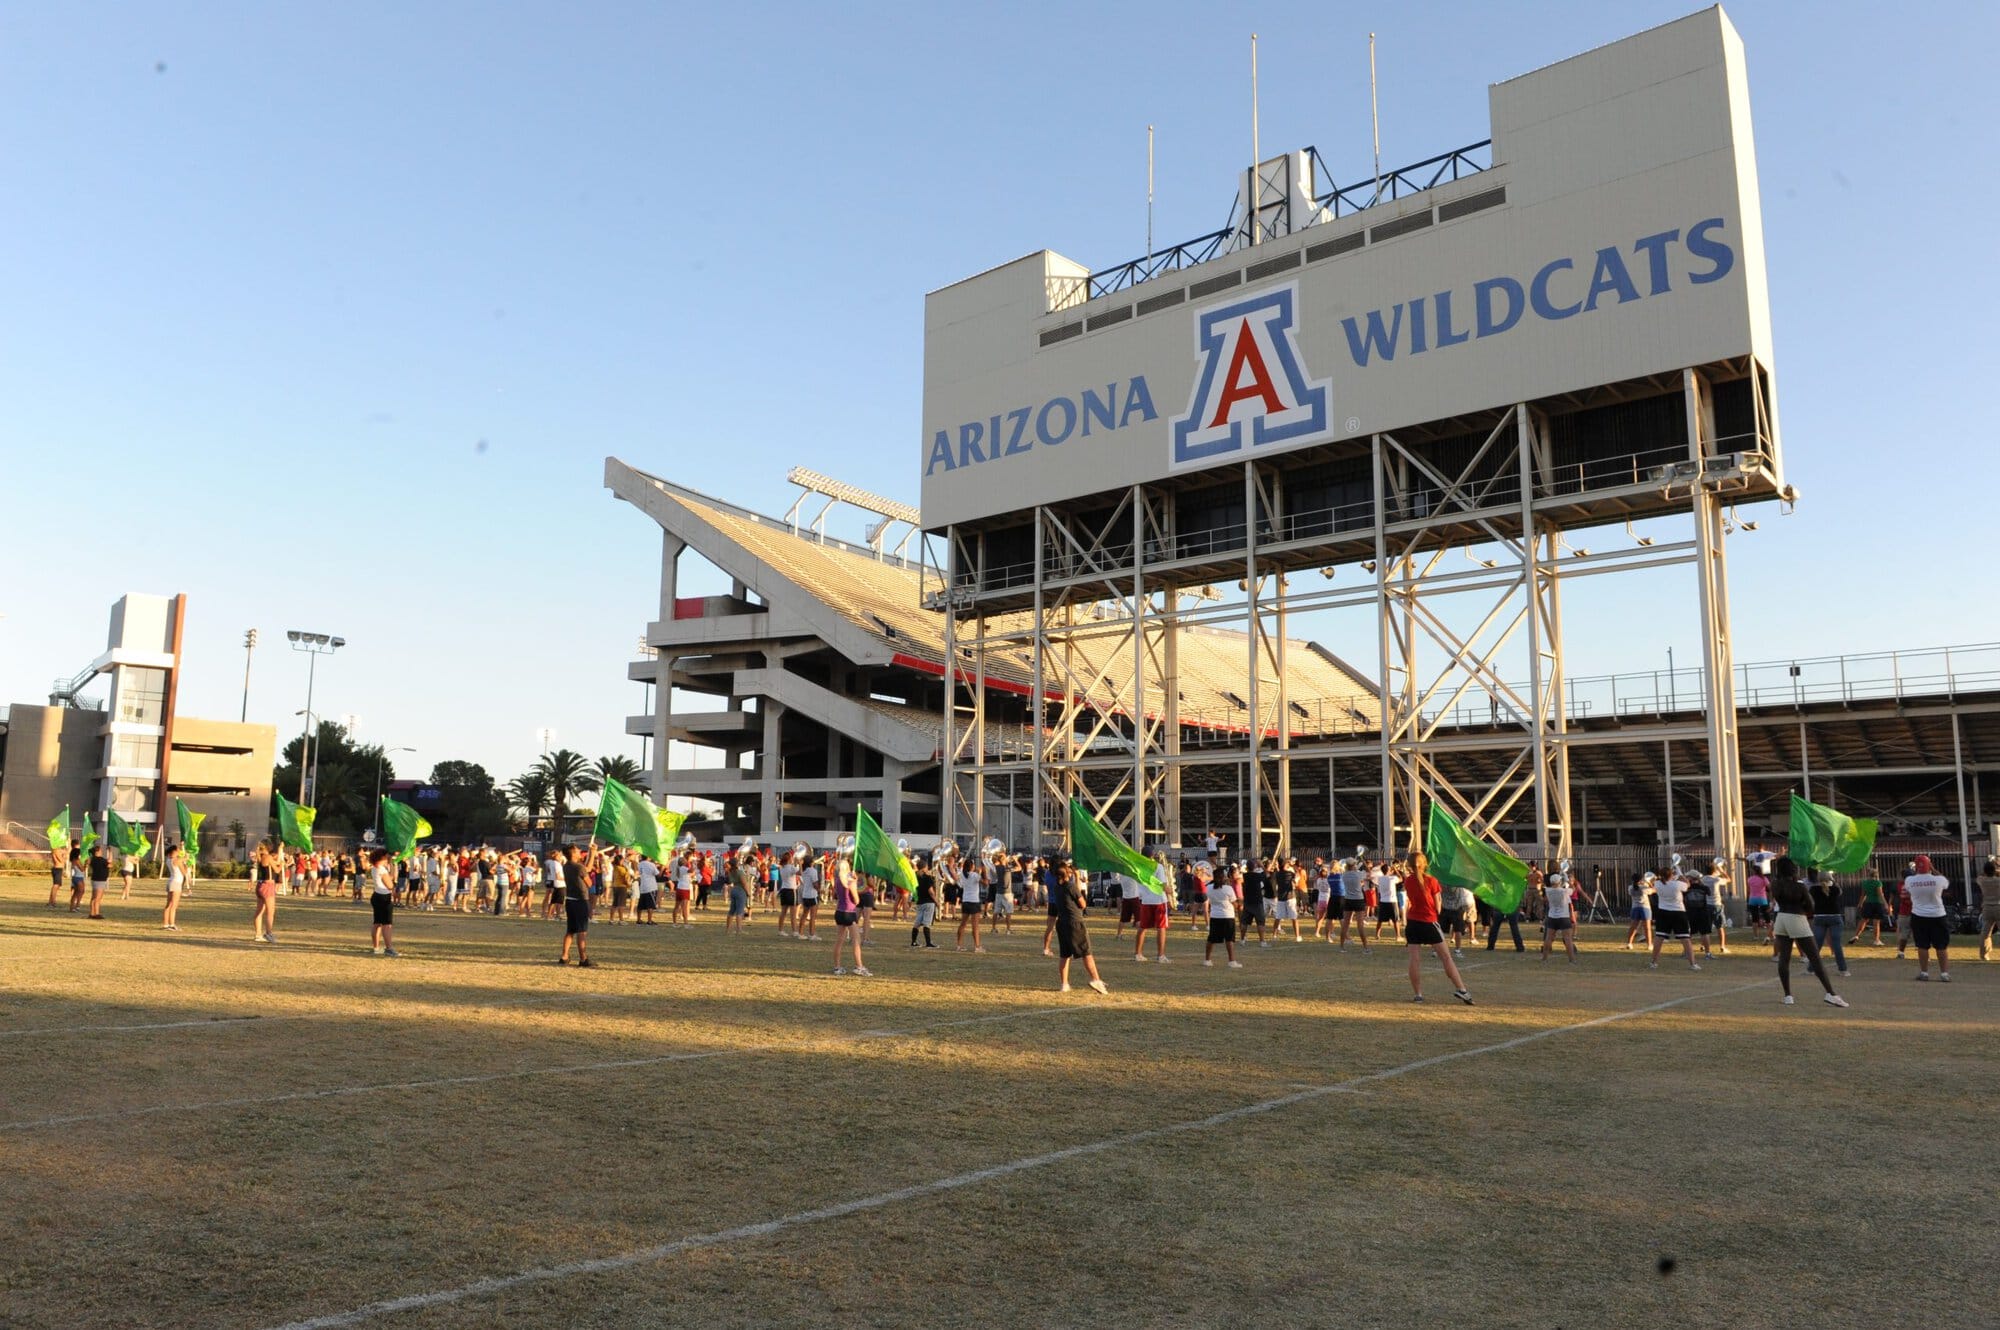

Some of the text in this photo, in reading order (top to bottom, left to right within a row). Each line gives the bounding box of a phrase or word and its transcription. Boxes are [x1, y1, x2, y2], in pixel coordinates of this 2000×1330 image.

[925, 218, 1734, 475] ARIZONA A WILDCATS
